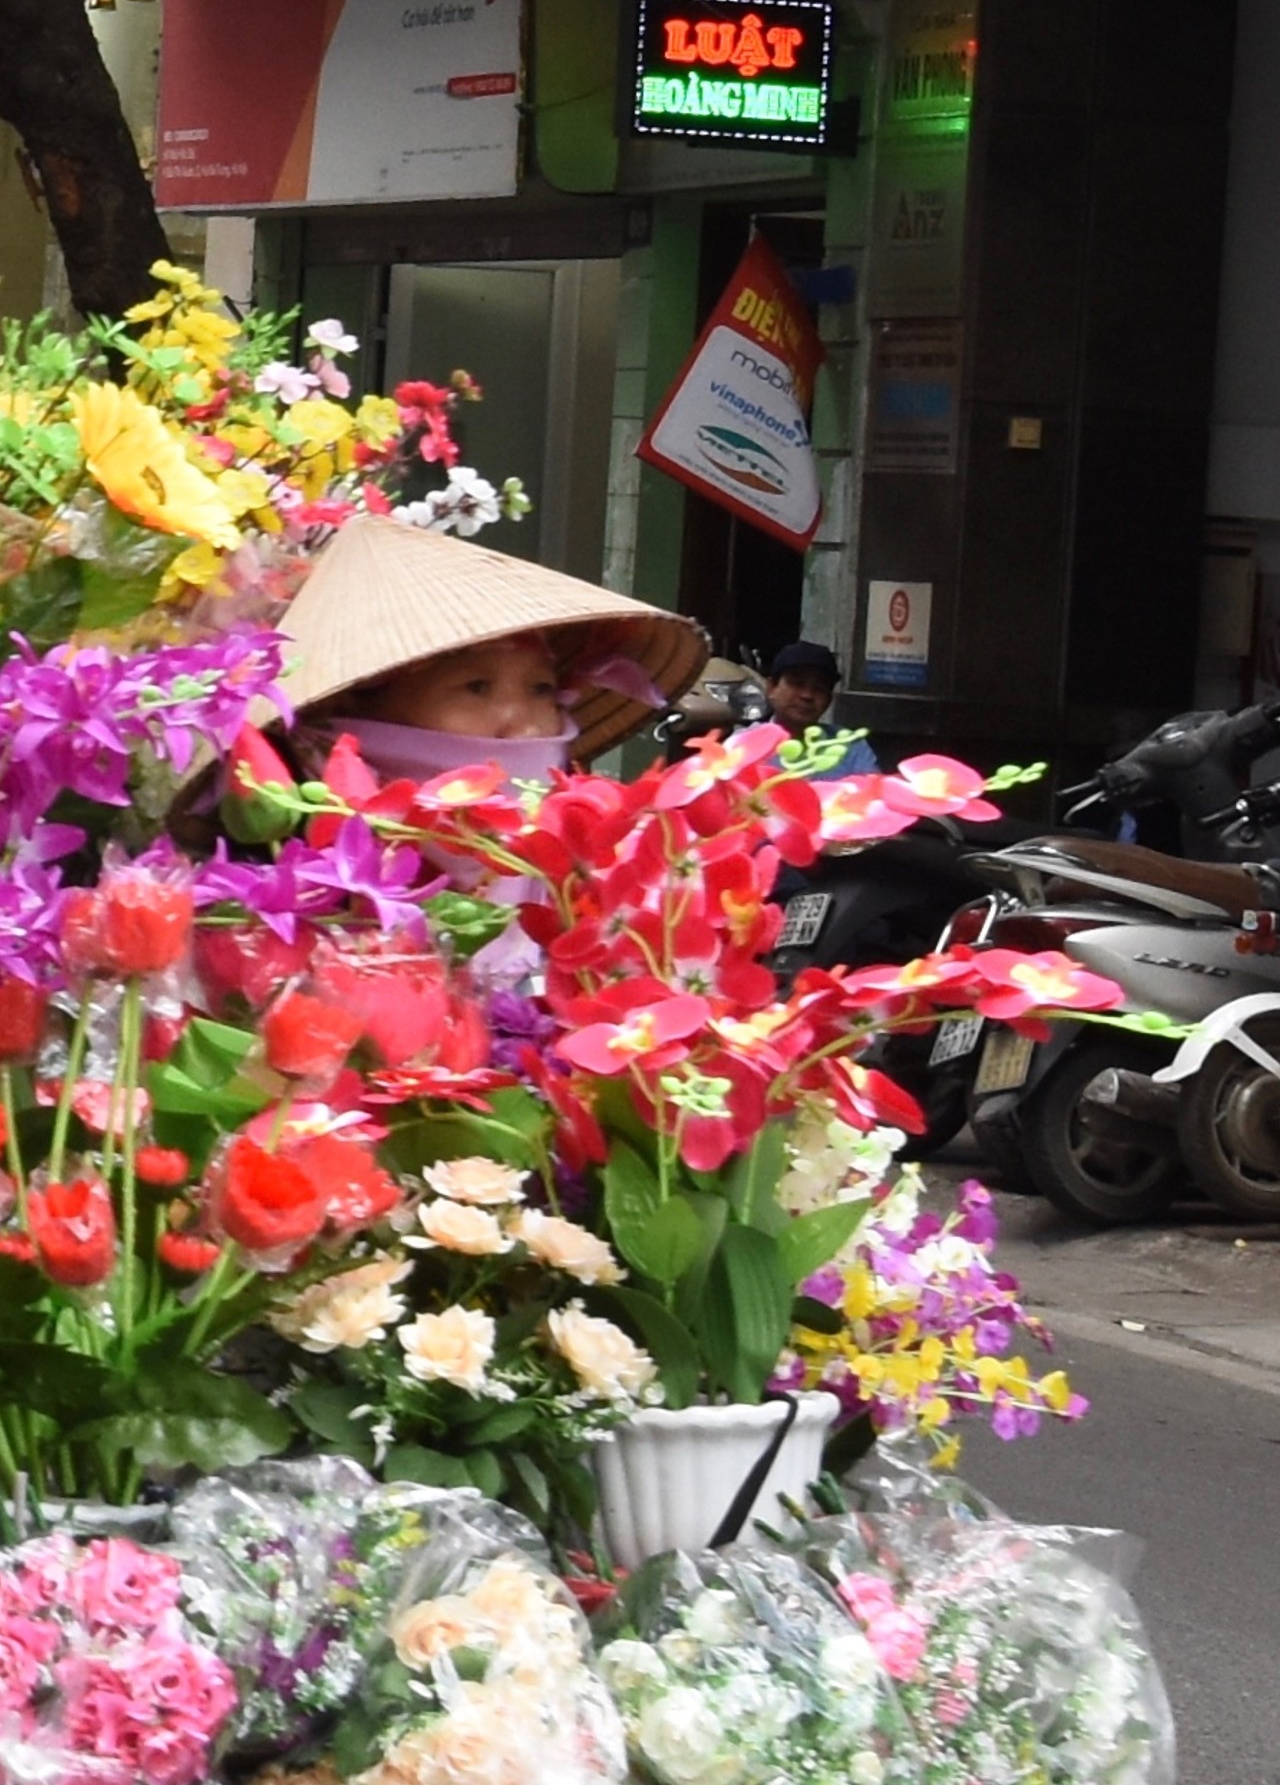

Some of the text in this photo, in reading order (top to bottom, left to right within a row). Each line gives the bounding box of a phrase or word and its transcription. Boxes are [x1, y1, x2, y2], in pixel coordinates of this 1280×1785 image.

[663, 13, 803, 76] LUẬT
[641, 70, 820, 123] HOÀNG MINH
[710, 379, 797, 441] vinaphone
